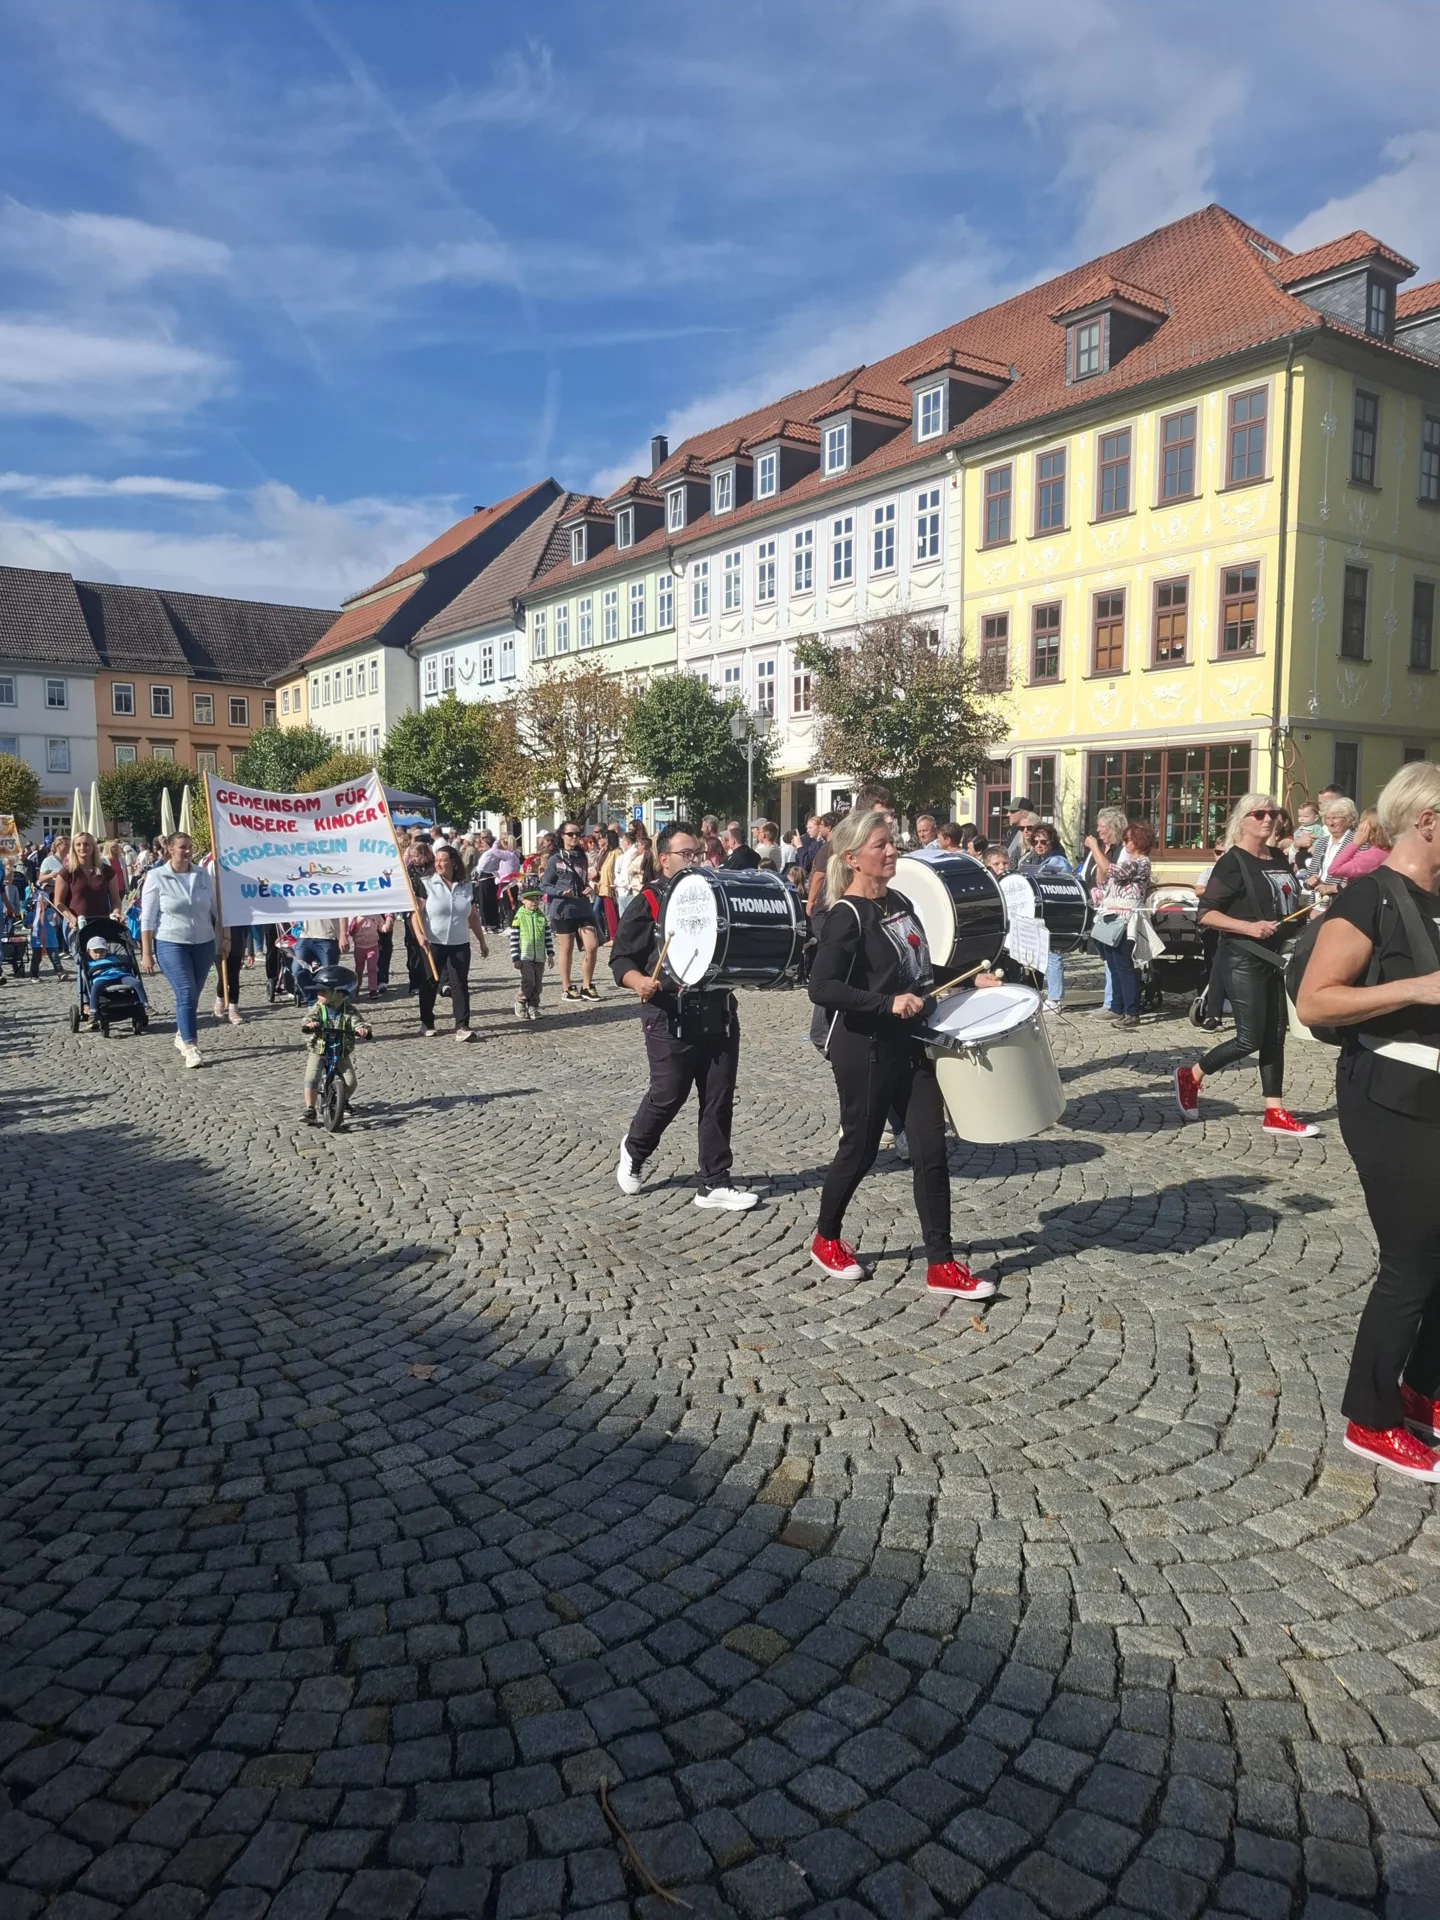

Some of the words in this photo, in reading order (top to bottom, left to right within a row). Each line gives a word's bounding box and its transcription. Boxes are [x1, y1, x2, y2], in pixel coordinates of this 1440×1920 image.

[216, 788, 321, 813] GEMEINSAM
[334, 787, 368, 807] FÜR
[228, 812, 299, 833] UNSERE
[314, 801, 387, 832] KINDER!
[218, 838, 348, 873] FÖRDERVEREIN
[358, 838, 398, 859] KITA
[240, 876, 392, 898] WERRASPATZEN
[1040, 884, 1080, 896] THOMANN
[730, 897, 788, 915] THOMANN
